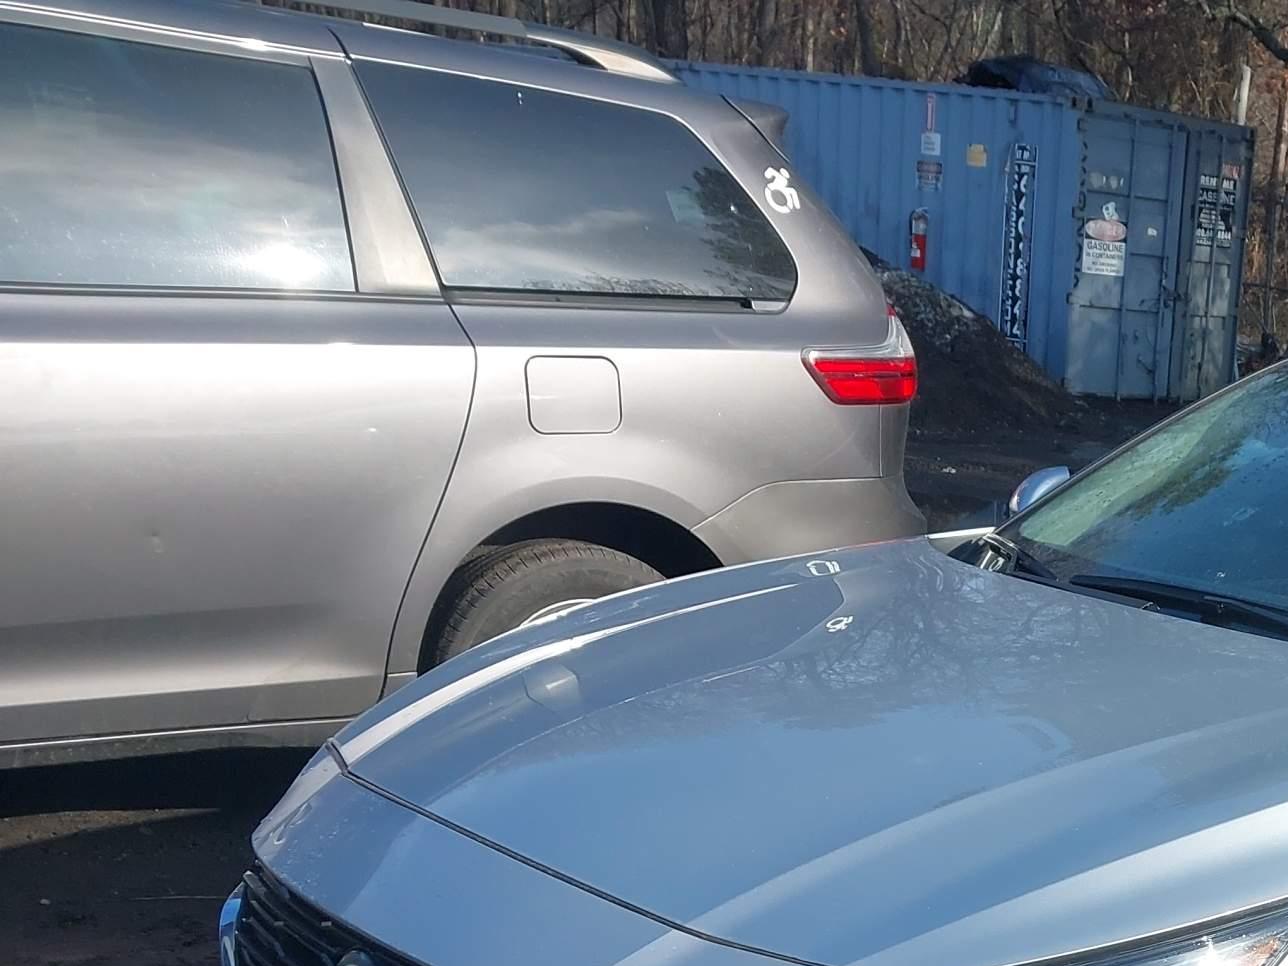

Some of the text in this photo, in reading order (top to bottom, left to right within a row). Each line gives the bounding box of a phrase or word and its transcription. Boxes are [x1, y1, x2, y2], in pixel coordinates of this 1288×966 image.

[1200, 175, 1217, 187] REN
[1199, 190, 1236, 206] CASSNE
[1087, 240, 1124, 253] GASOLINE
